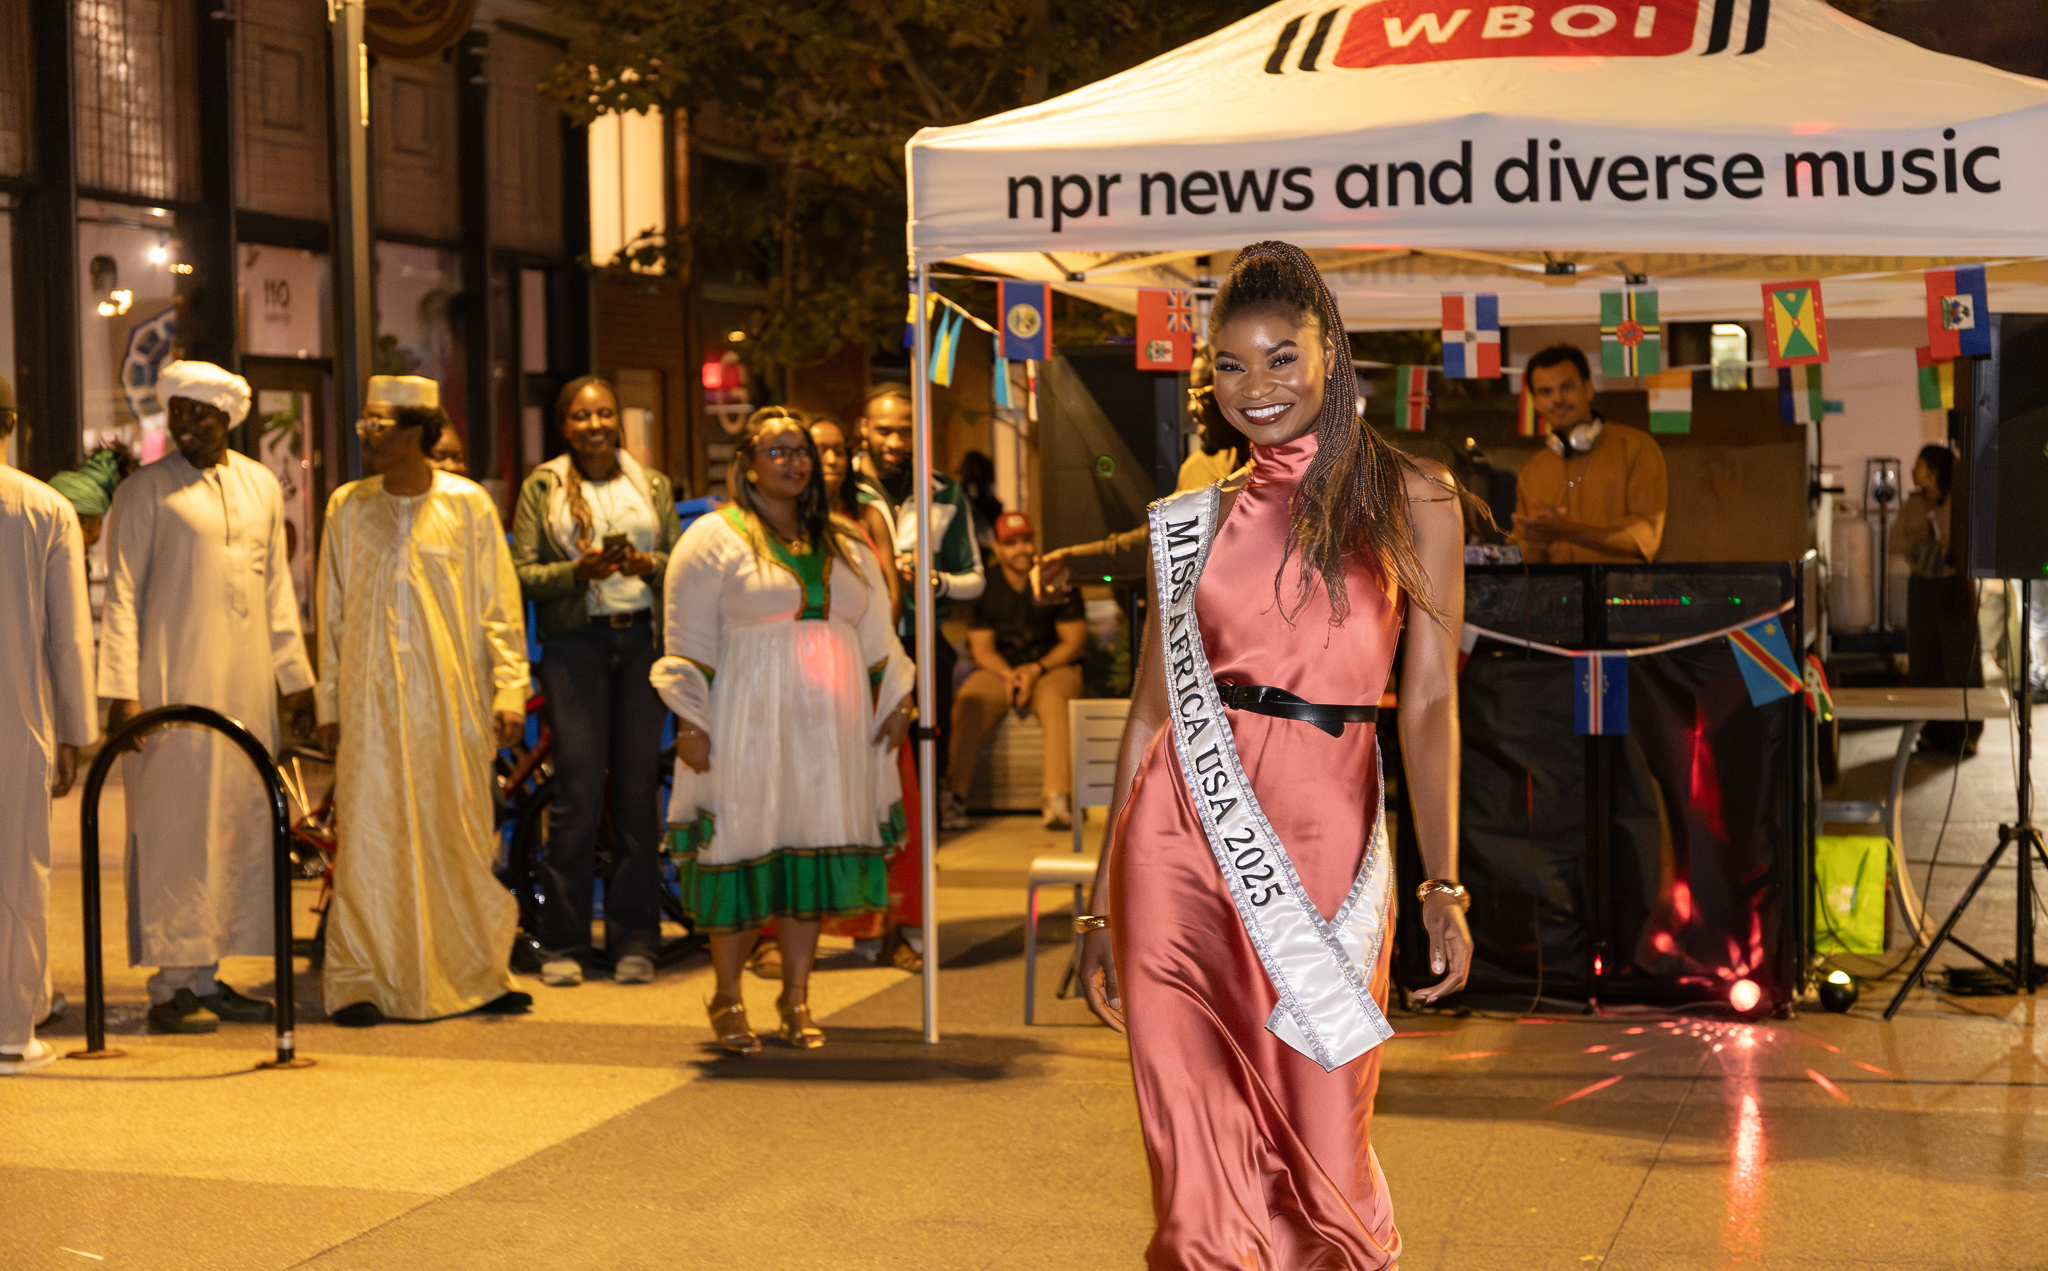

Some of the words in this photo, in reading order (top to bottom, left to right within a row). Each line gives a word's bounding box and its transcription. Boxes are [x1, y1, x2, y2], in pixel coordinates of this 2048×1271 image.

[1382, 4, 1657, 49] WBOI
[1008, 173, 1122, 233] npr
[1140, 166, 1315, 216] news
[1335, 140, 1473, 209] and
[1494, 138, 1765, 204] diverse
[1785, 127, 2001, 198] music
[1165, 515, 1200, 605] MISS
[1168, 613, 1210, 746] AFRICA
[1195, 743, 1239, 825] USA
[1223, 827, 1287, 908] 2025
